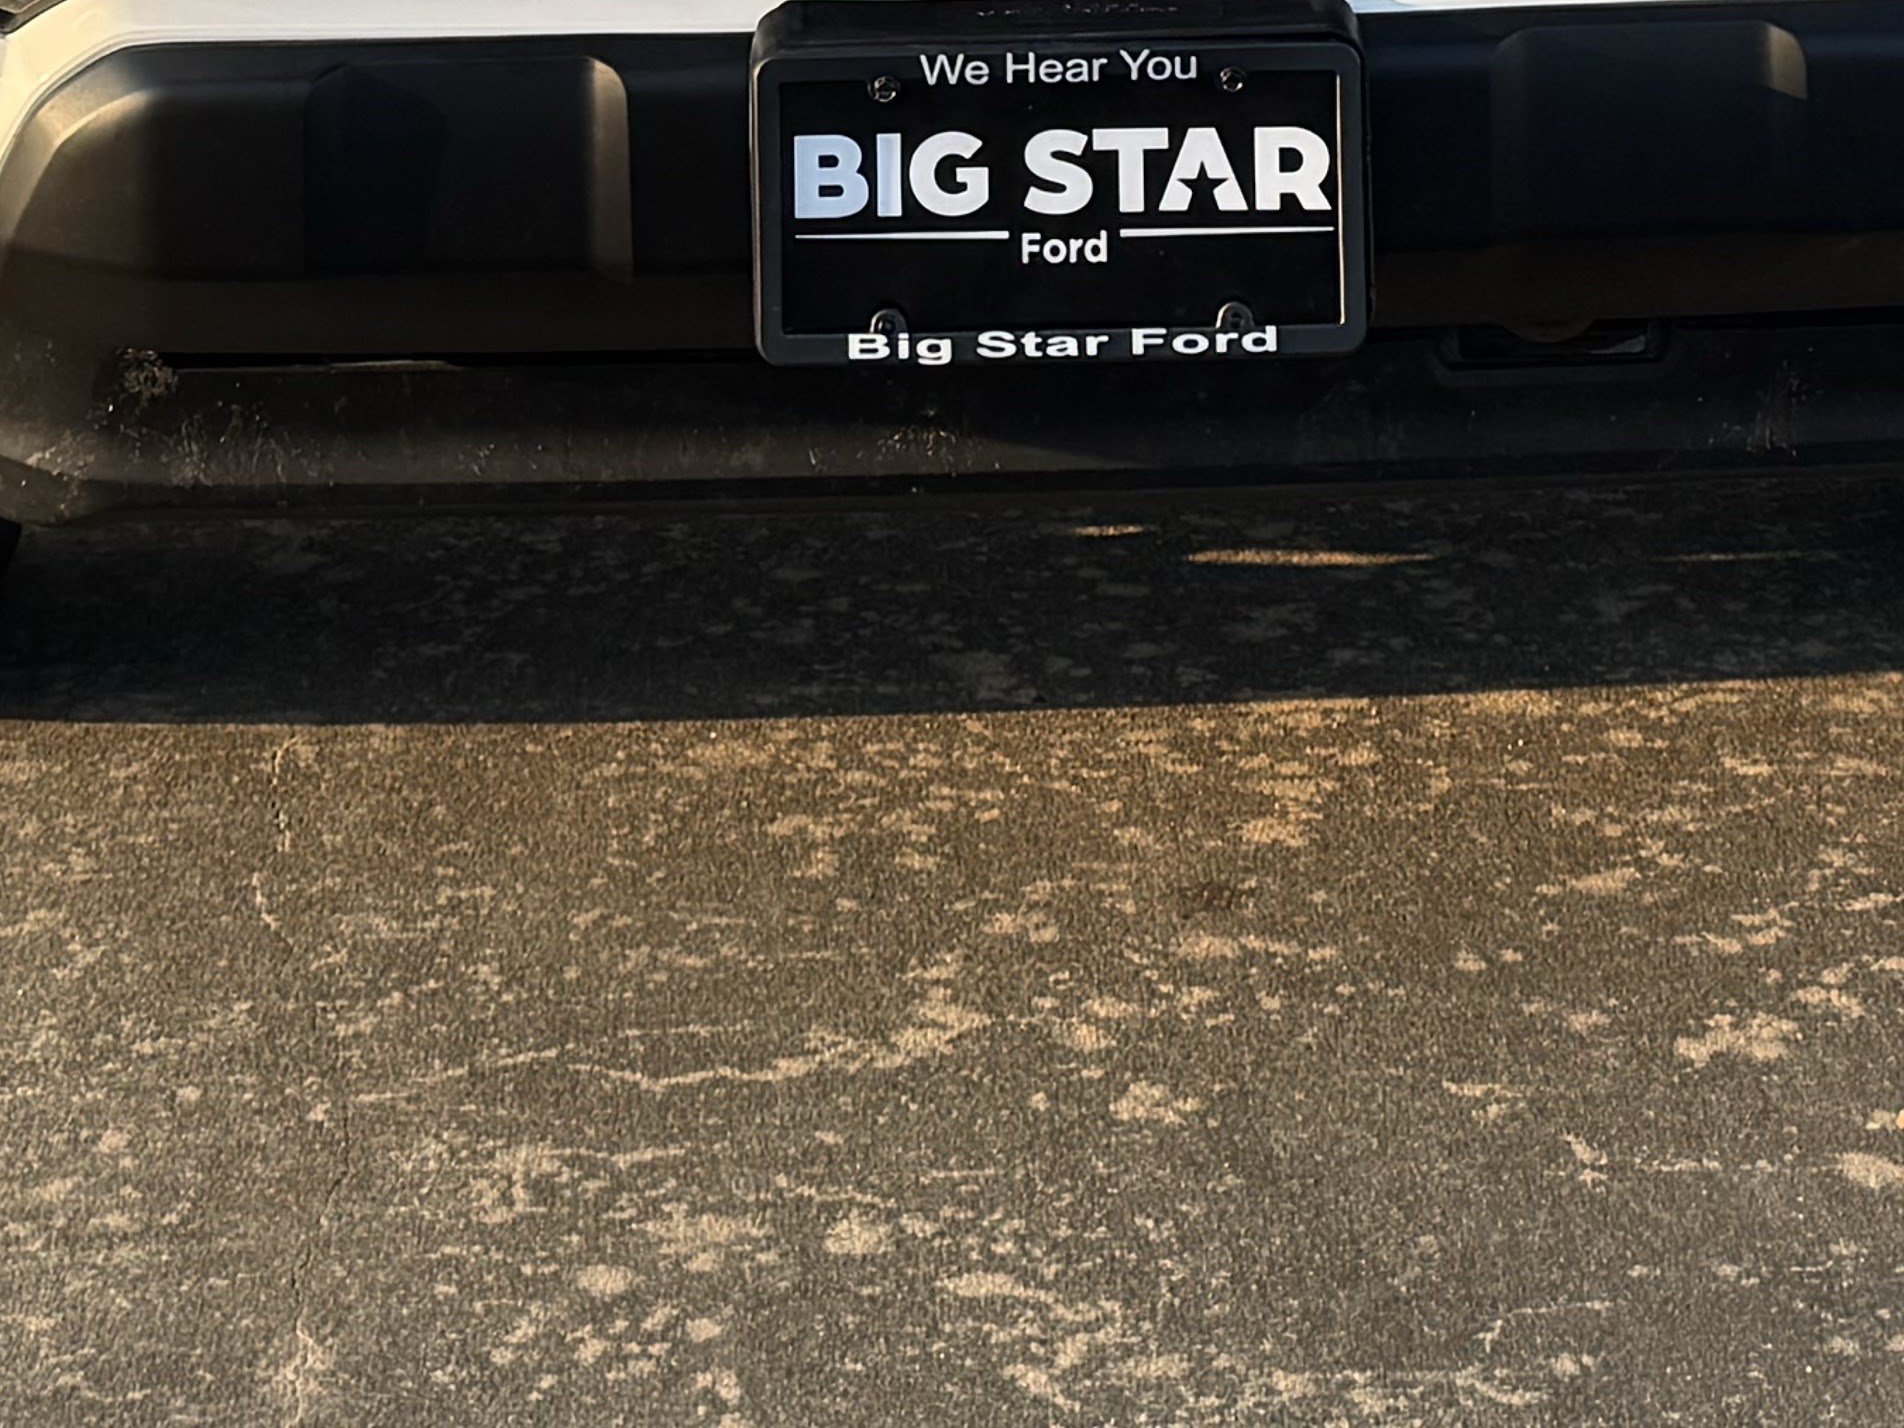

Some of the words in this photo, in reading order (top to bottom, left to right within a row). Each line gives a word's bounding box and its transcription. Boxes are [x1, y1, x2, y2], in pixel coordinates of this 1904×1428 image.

[919, 53, 990, 86] We
[1006, 51, 1108, 84] Hear
[1119, 48, 1197, 81] You
[794, 132, 989, 218] BIG
[1024, 127, 1331, 214] STAR
[1021, 230, 1108, 264] Ford
[847, 329, 953, 365] Big
[976, 330, 1110, 359] Star
[1131, 325, 1278, 356] Ford
